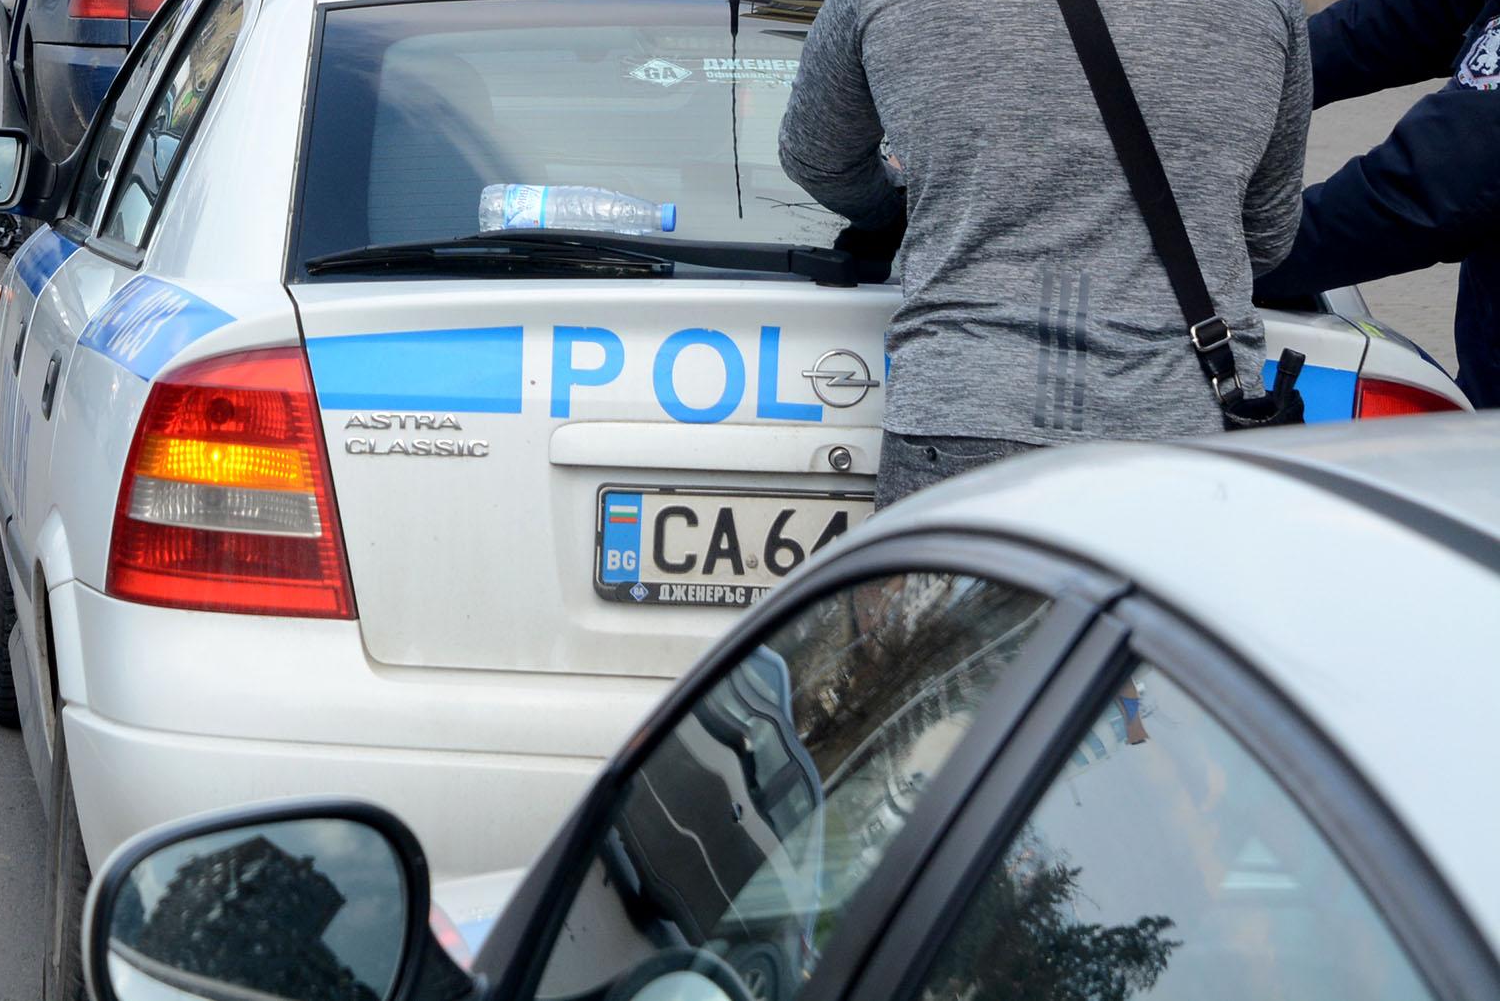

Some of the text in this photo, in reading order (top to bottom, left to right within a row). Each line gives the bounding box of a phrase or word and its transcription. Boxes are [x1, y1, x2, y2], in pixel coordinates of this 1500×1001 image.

[549, 326, 892, 424] POL
[344, 411, 463, 431] ASTRA
[344, 437, 489, 457] CLASSIC
[652, 505, 745, 576] CA
[606, 549, 637, 571] BG
[658, 583, 746, 604] ДЖЕНЕРЪС
